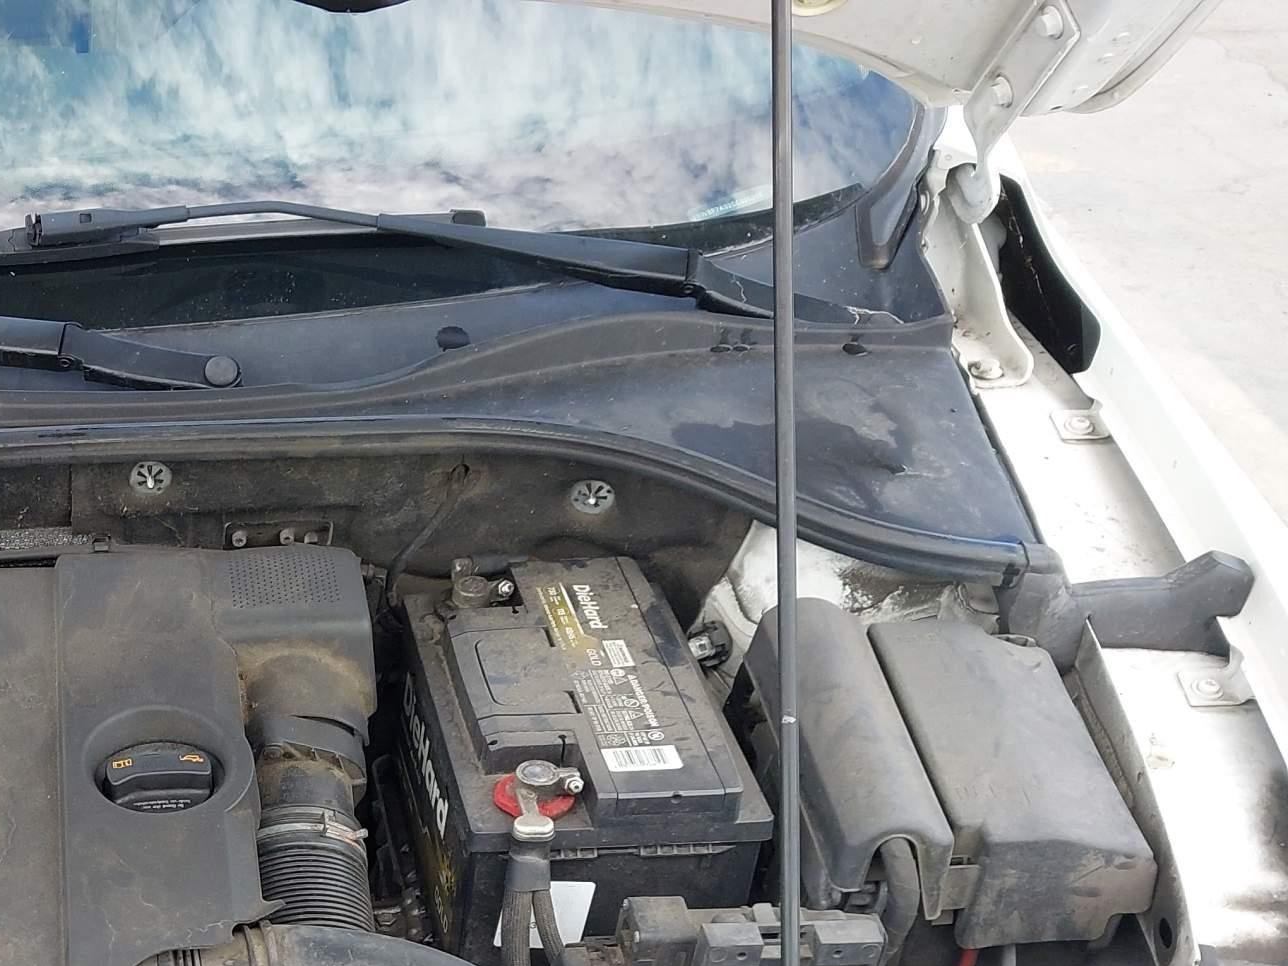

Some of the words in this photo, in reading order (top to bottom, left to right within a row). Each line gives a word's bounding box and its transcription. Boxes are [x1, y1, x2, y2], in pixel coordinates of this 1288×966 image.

[572, 584, 608, 629] DieHard
[586, 648, 602, 667] GOLD
[642, 703, 660, 727] POISON
[404, 672, 449, 841] DieHard
